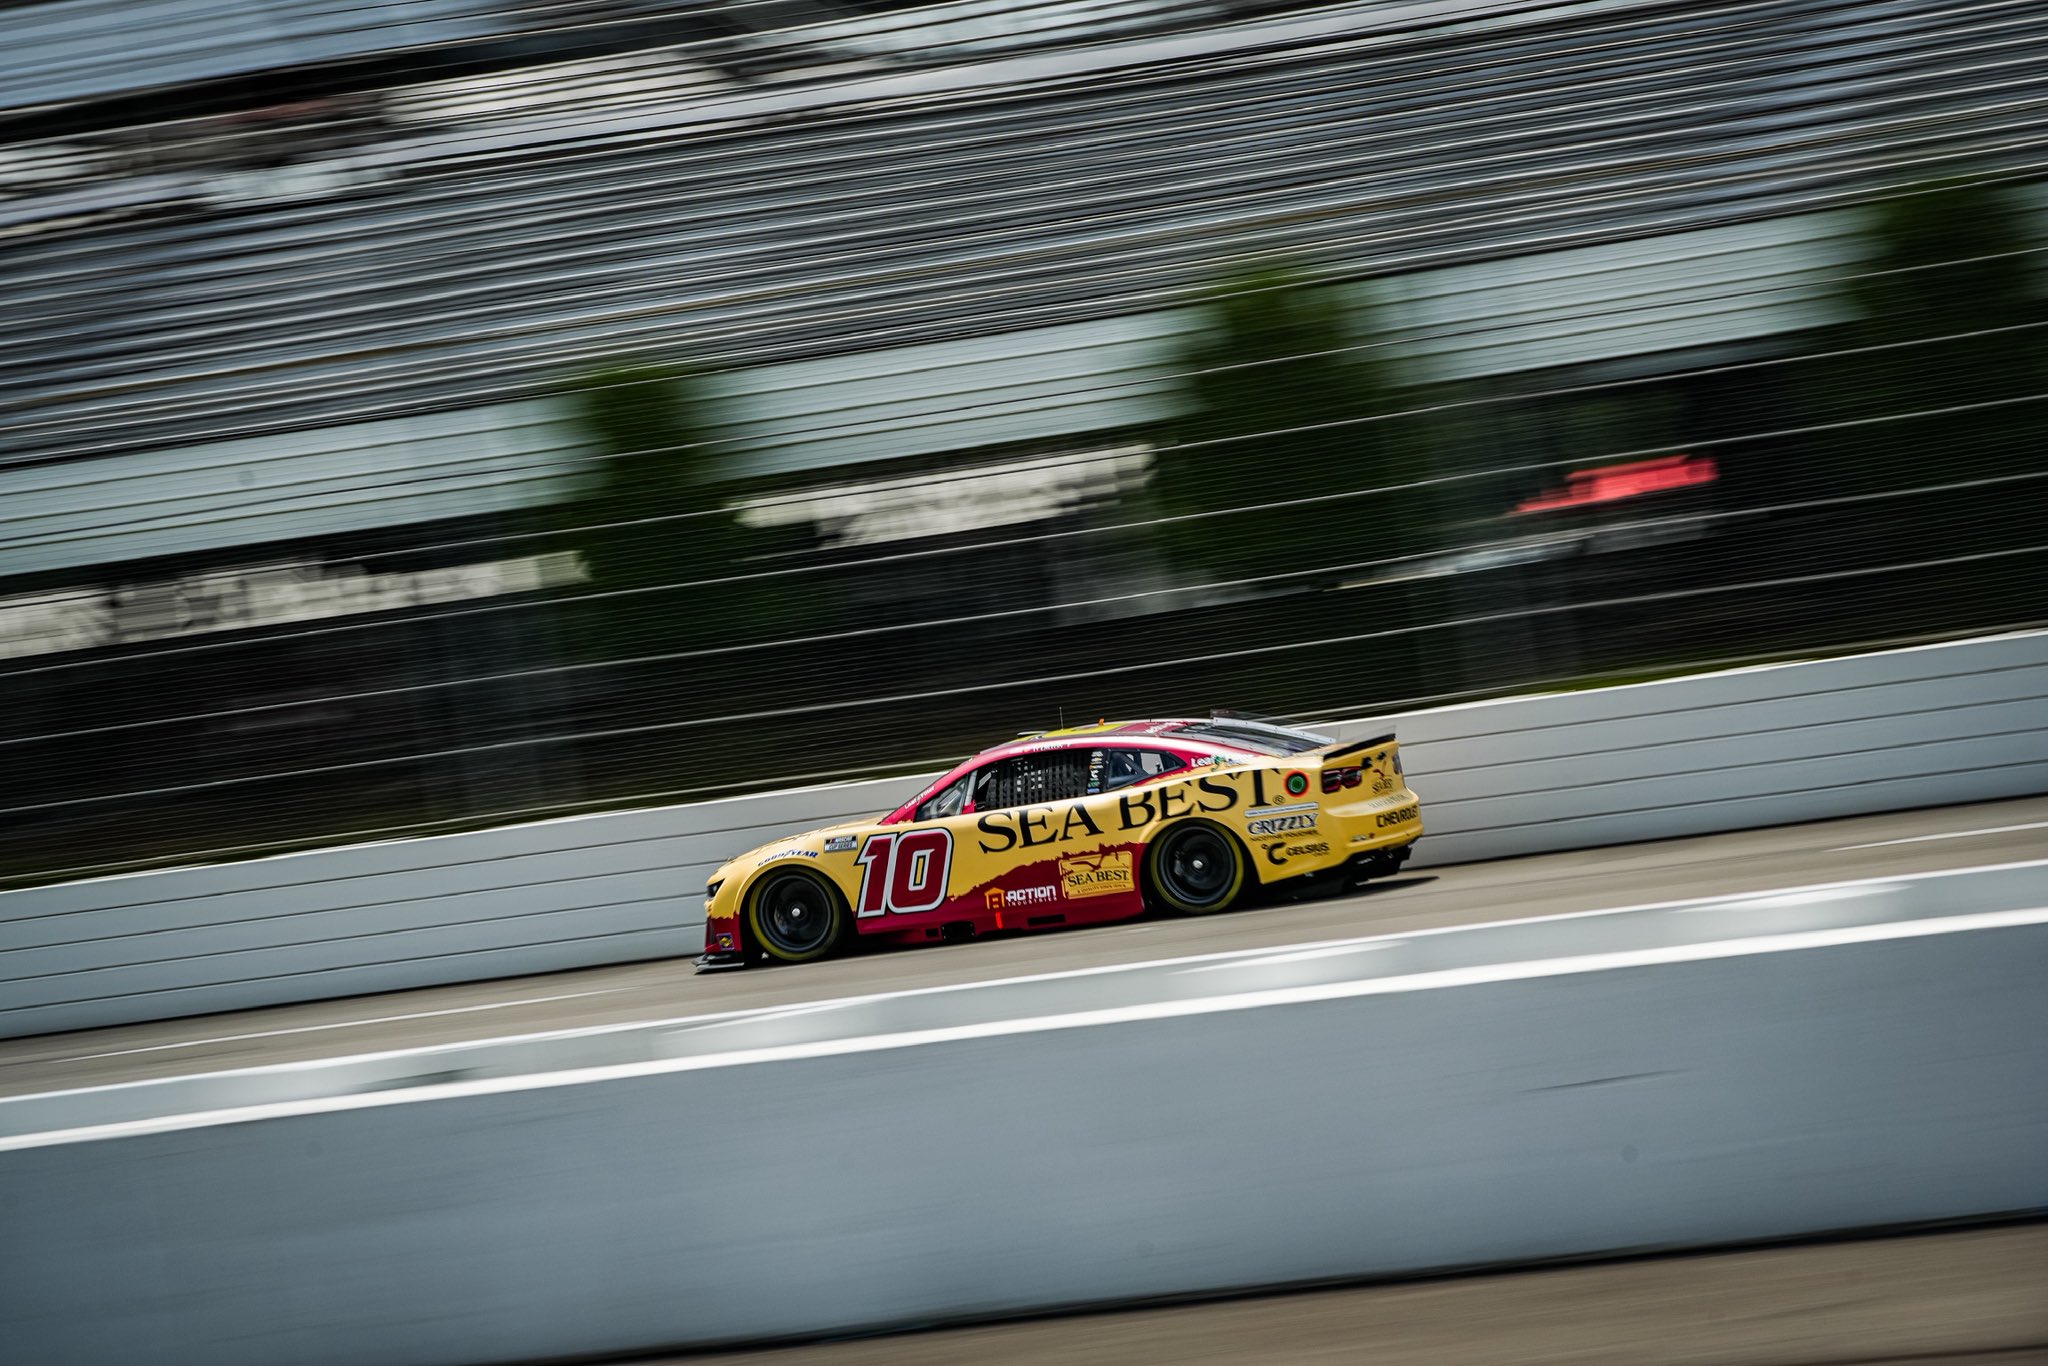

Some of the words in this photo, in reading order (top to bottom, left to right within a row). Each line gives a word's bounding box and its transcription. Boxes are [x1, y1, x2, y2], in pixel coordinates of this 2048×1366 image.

[977, 802, 1104, 854] SEA
[1118, 768, 1281, 831] BEST
[1248, 813, 1318, 834] GRIZZLY
[854, 827, 953, 919] 10
[1068, 872, 1094, 888] SEA
[1096, 869, 1130, 883] BEST
[1006, 885, 1056, 902] ACTION
[1008, 897, 1058, 907] INDUSTRIES
